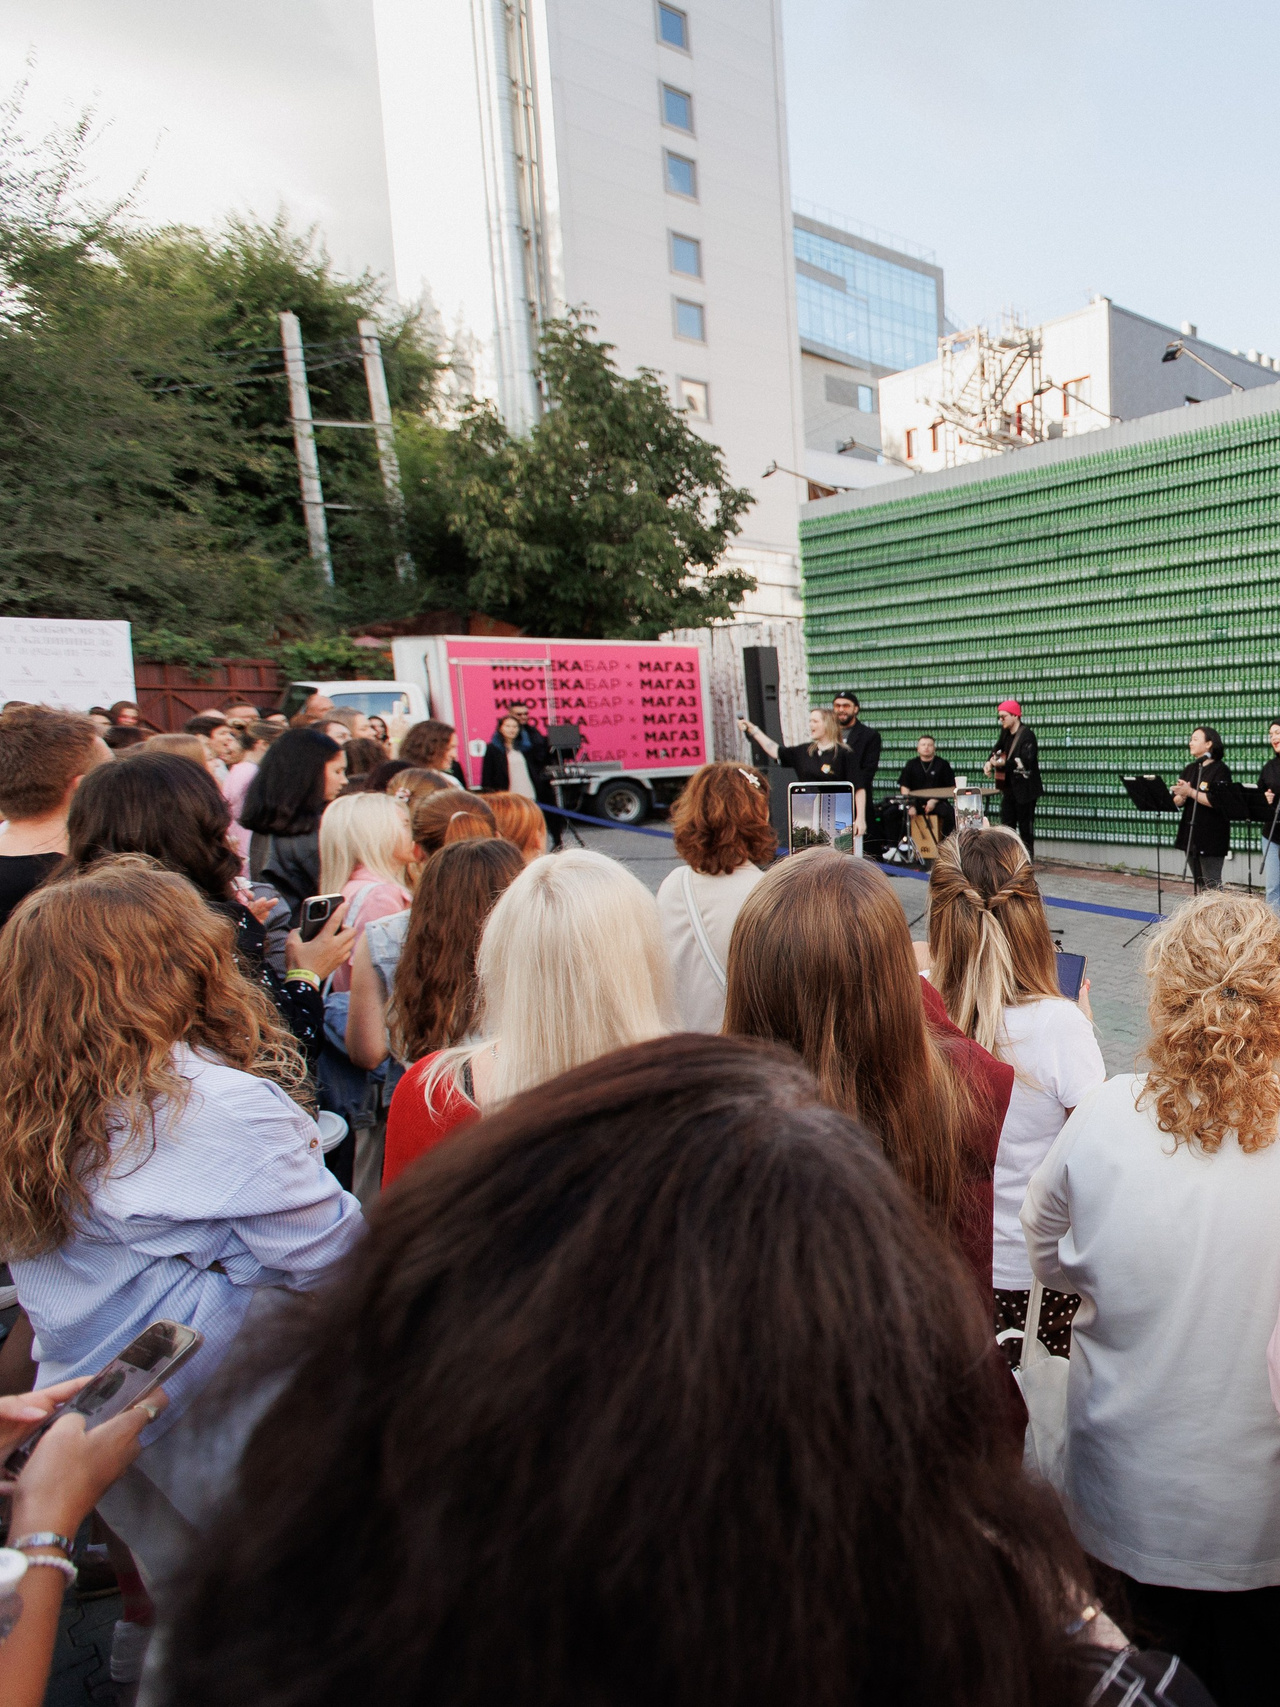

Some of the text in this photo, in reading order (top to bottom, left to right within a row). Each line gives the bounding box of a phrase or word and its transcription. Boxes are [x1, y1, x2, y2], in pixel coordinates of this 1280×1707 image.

[638, 660, 694, 673] МАГАЗ
[640, 678, 695, 690] МАГАЗ
[641, 696, 697, 707] МАГАЗ
[642, 713, 698, 725] МАГАЗ
[644, 730, 699, 742] МАГАЗ
[645, 747, 700, 759] МАГАЗ
